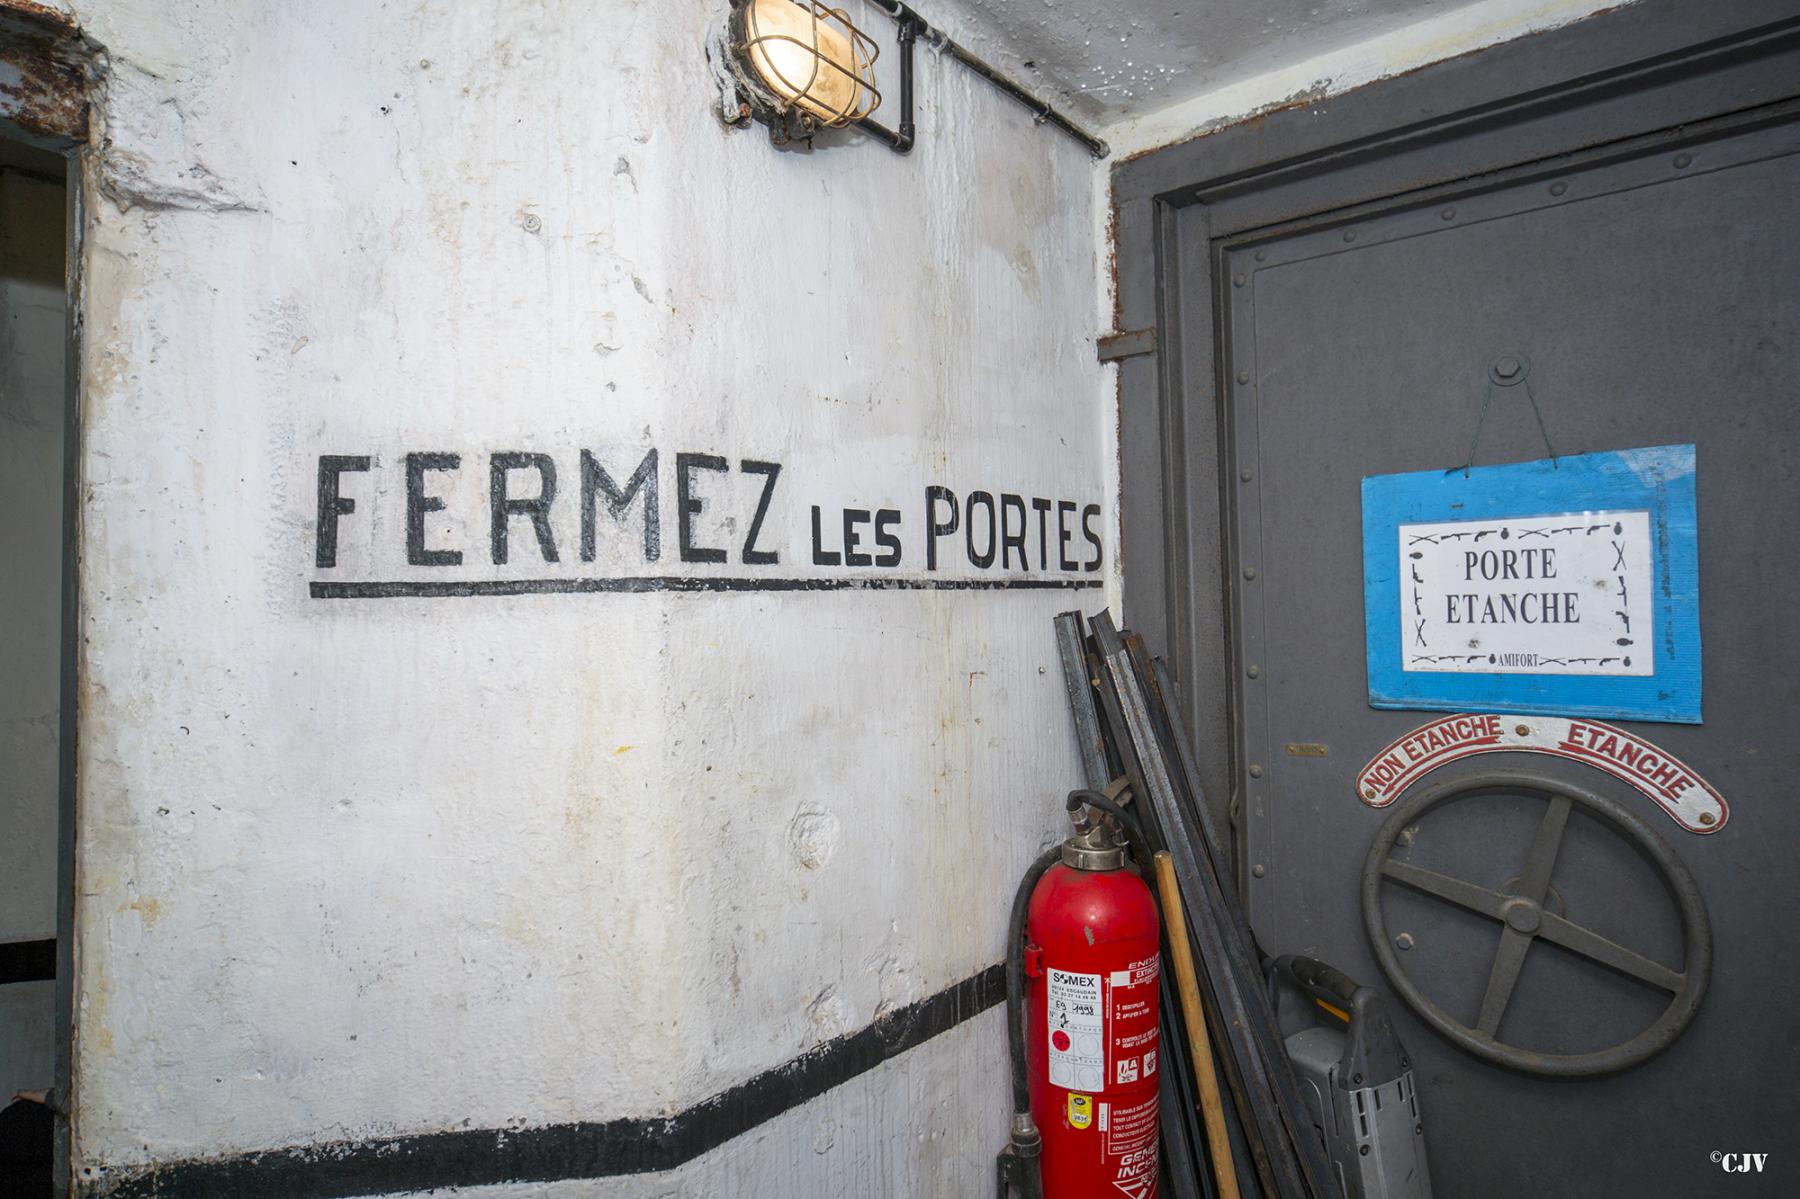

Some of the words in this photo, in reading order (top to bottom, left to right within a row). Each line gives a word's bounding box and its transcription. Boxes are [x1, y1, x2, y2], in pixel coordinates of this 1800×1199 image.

[317, 447, 780, 568] FERMEZ
[811, 505, 903, 567] LES
[925, 485, 1104, 571] PORTES
[1464, 547, 1558, 581] PORTE
[1446, 592, 1581, 624] ETANCHE
[1498, 653, 1539, 668] AMIFORT
[1367, 758, 1406, 795] NON
[1403, 714, 1505, 762] ETANCHE
[1566, 722, 1697, 802] ETANCHE
[1053, 972, 1095, 987] SOMEX
[1116, 1003, 1121, 1012] 1
[1115, 1012, 1121, 1020] 2
[1115, 1038, 1121, 1046] 3
[1130, 1059, 1137, 1069] A
